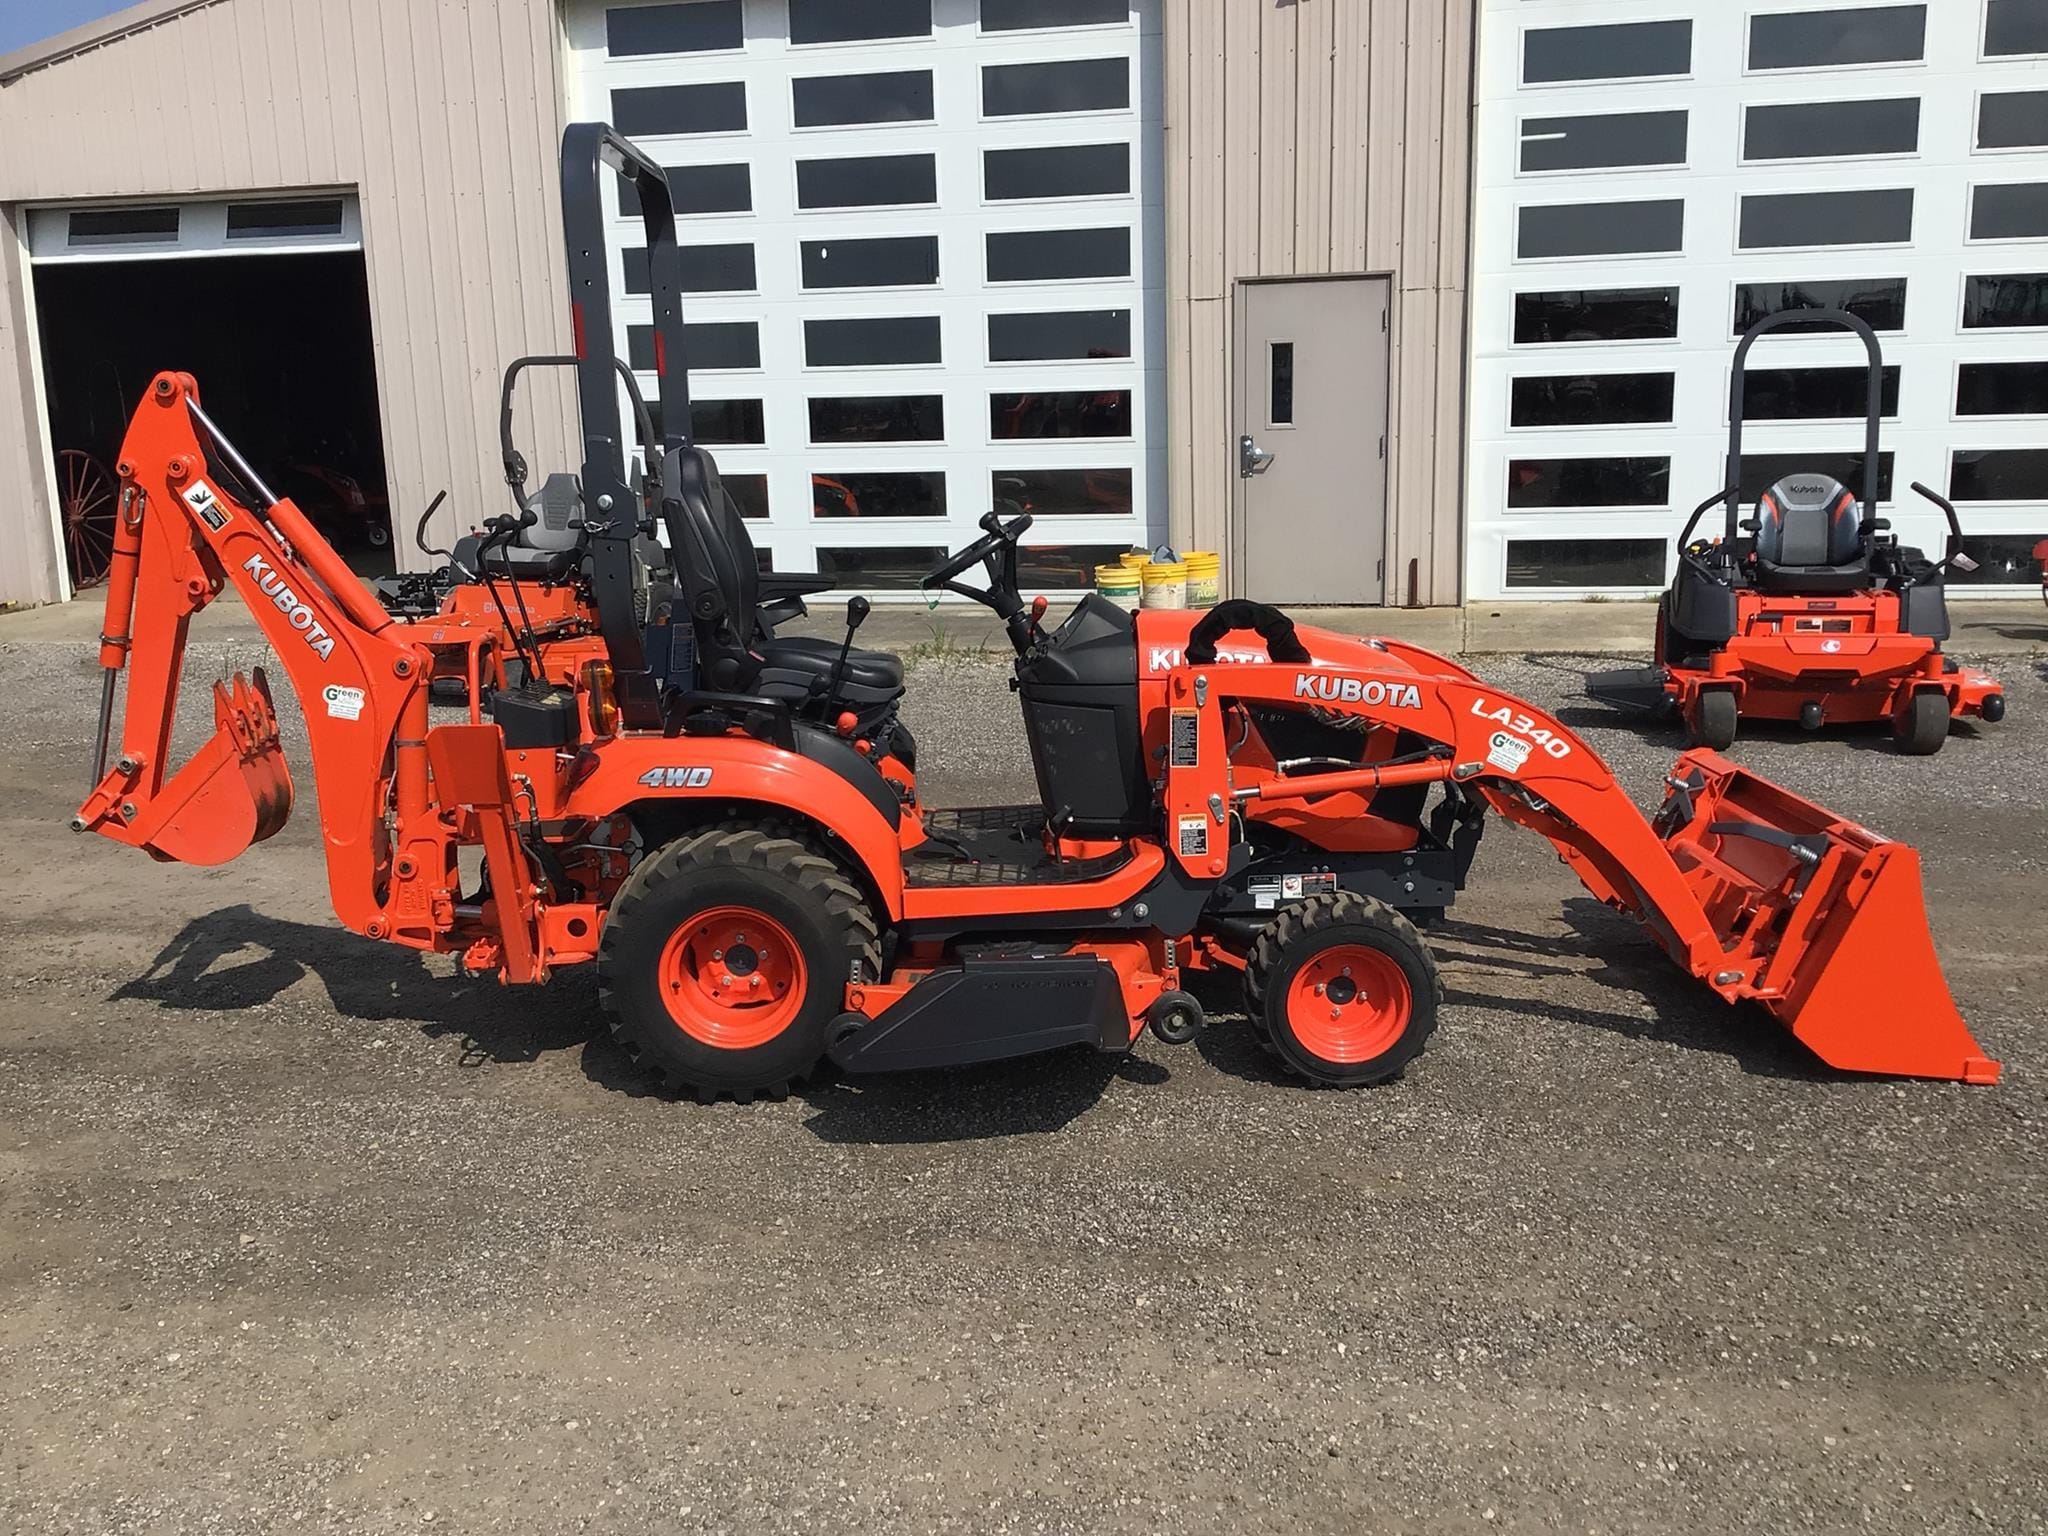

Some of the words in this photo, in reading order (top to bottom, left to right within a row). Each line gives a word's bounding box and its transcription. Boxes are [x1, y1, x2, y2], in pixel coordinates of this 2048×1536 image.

[242, 552, 336, 662] KUBOTA
[326, 687, 360, 701] Green
[1294, 673, 1423, 709] KUBOTA
[1471, 697, 1571, 759] LA340
[1492, 733, 1528, 753] Green
[638, 766, 714, 788] 4WD
